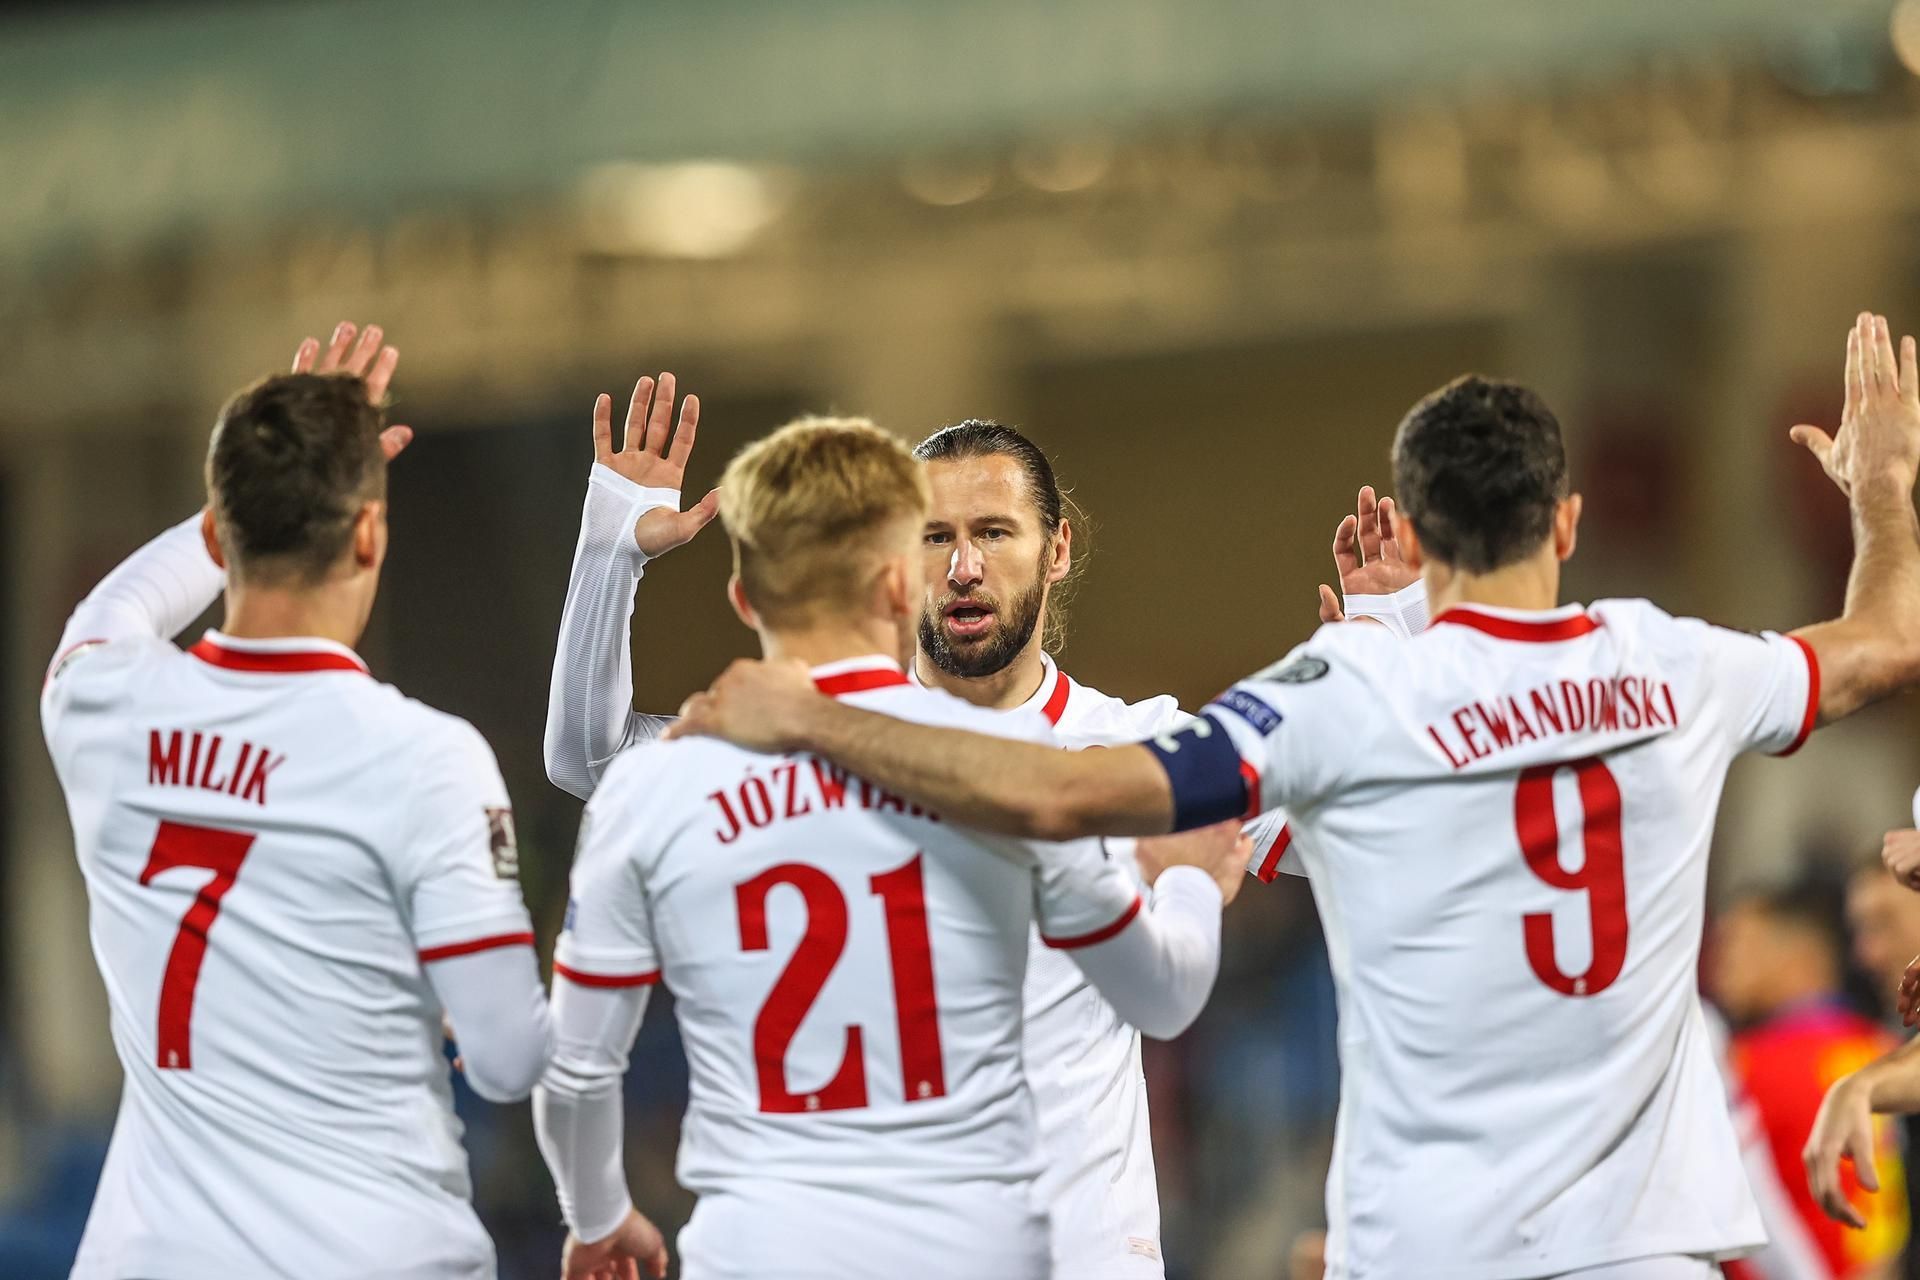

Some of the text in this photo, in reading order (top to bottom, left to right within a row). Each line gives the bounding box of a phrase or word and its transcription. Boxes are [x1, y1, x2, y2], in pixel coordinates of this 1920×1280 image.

[148, 729, 286, 806] MILIK
[1426, 676, 1679, 770] LEWANDOWSKI
[139, 819, 257, 1071] 7
[734, 850, 947, 1115] 21
[1513, 757, 1629, 997] 9
